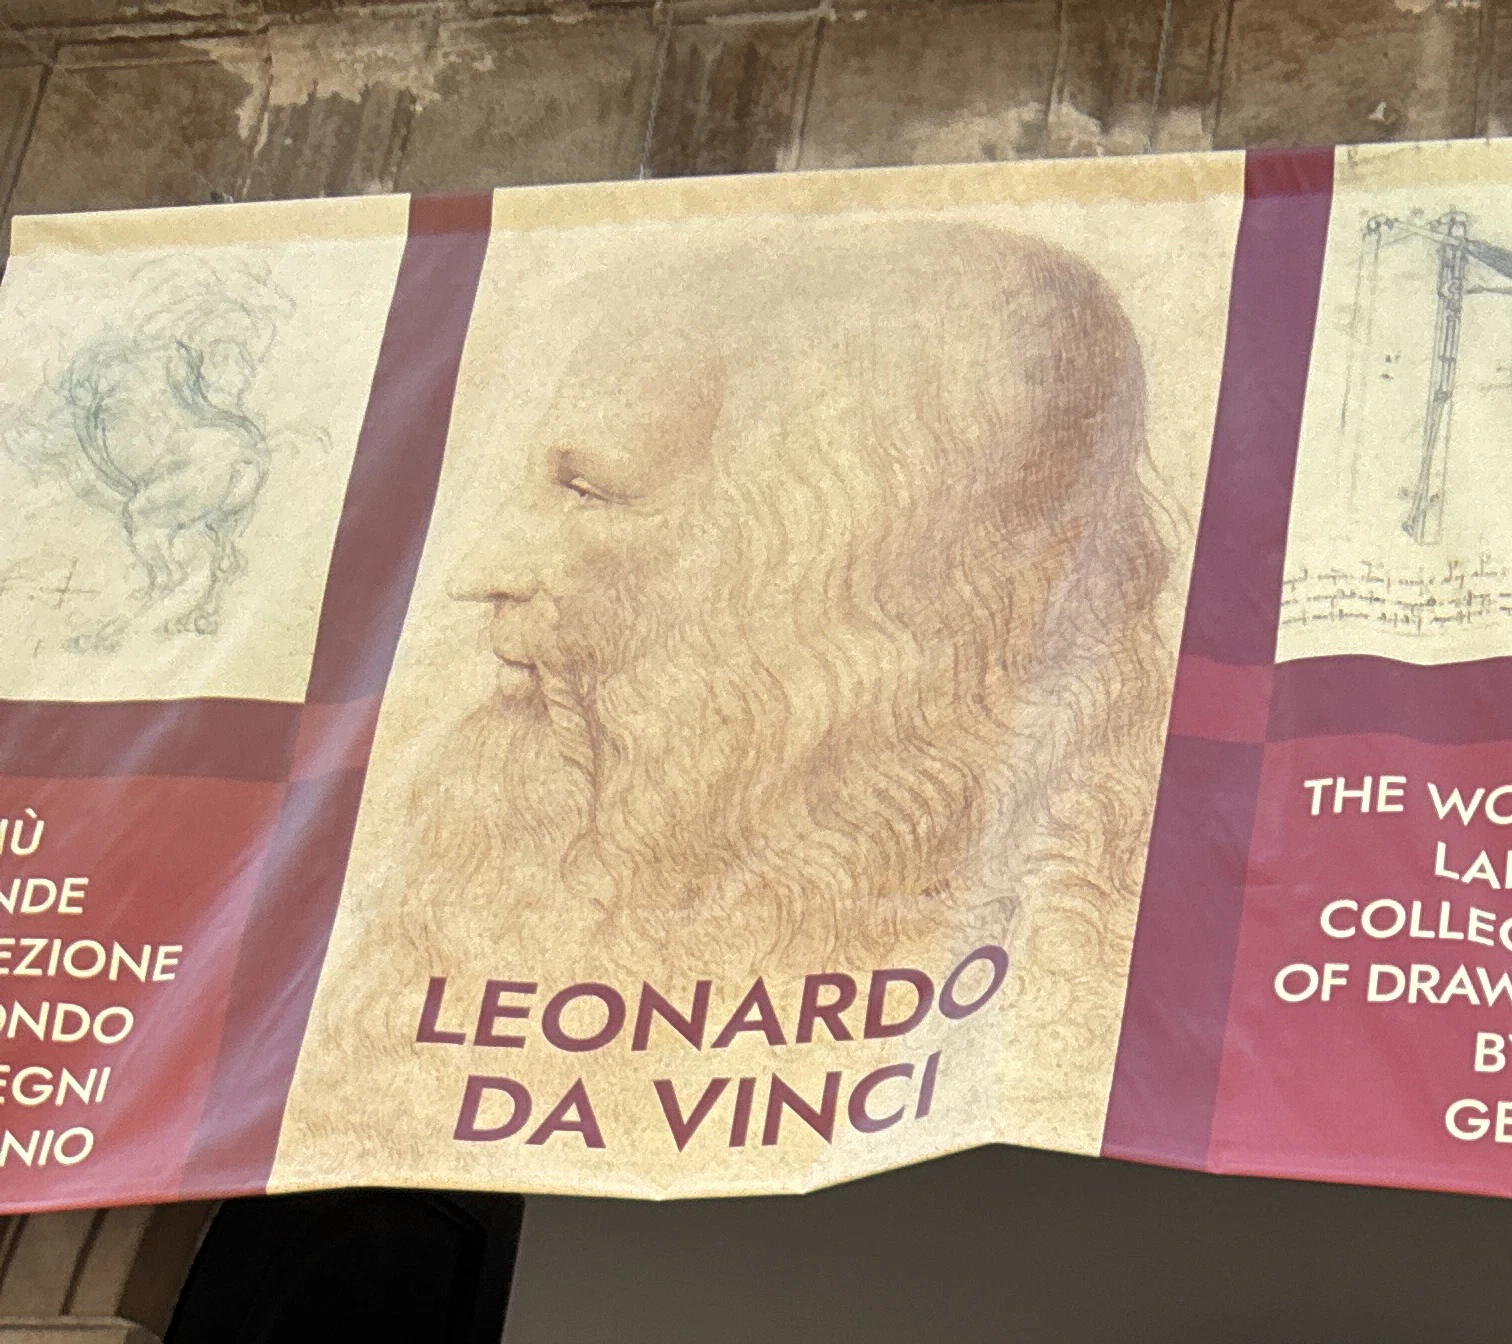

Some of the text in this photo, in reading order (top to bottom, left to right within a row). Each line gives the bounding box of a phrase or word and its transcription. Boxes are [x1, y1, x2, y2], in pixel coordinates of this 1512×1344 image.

[1303, 775, 1407, 816] THE
[415, 944, 1010, 1053] LEONARDO
[1274, 962, 1350, 1003] OF
[0, 1000, 134, 1044] NDO
[453, 1051, 941, 1152] DA VINCI
